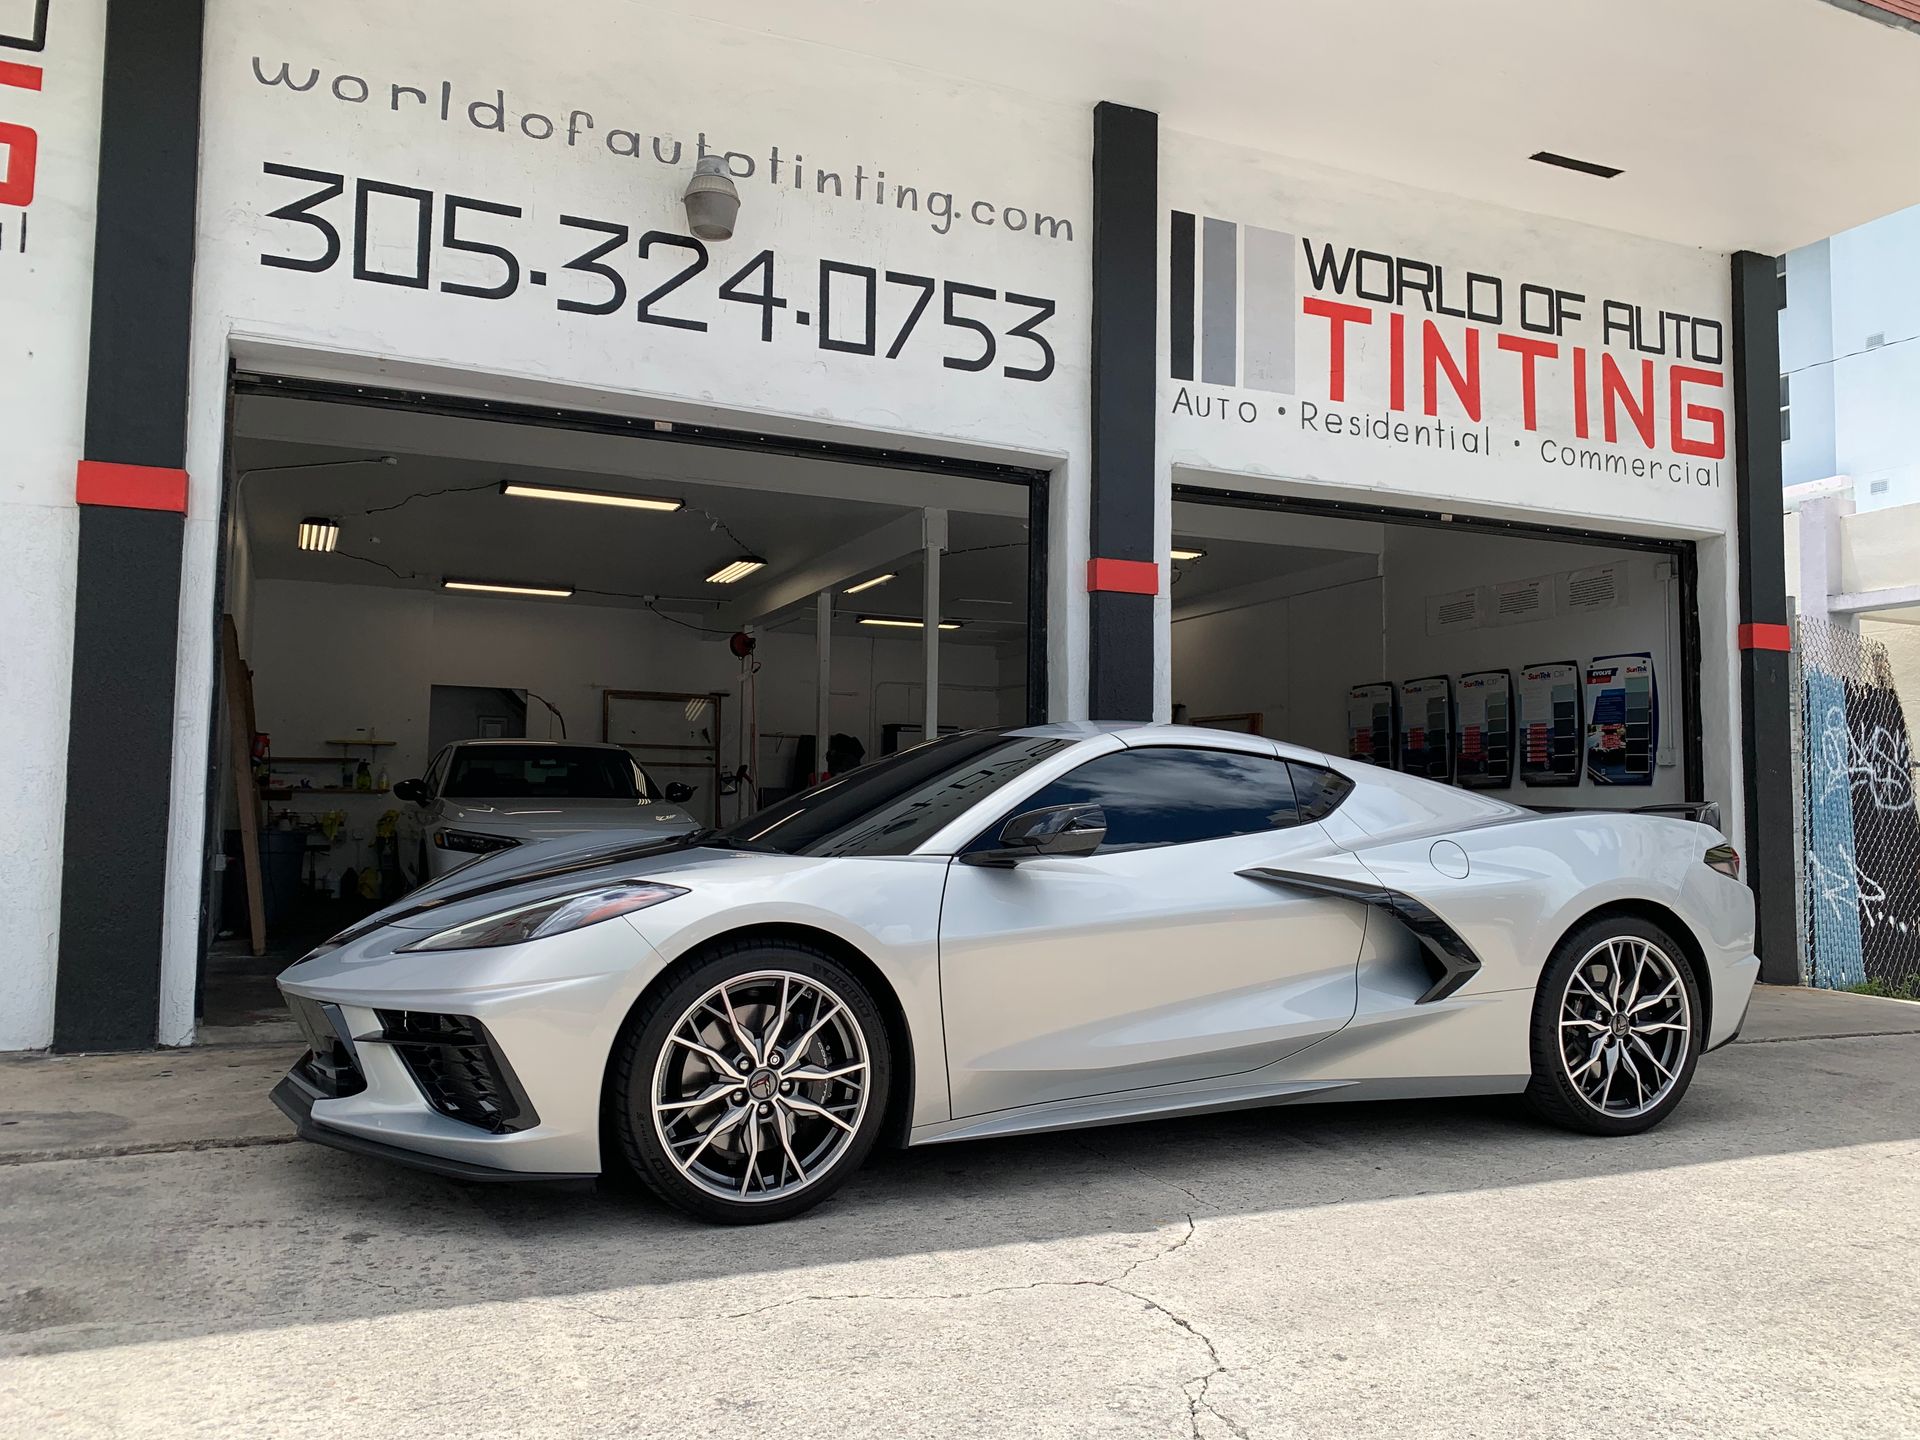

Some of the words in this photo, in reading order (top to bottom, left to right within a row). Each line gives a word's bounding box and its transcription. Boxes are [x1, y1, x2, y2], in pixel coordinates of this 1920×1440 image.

[252, 56, 1073, 242] worldofautotinting.com
[1302, 237, 1503, 326] WORLD
[1520, 283, 1586, 337] OF
[1603, 299, 1723, 365] AUTO
[1303, 296, 1726, 460] TINTING
[1301, 401, 1489, 456] Residential
[1540, 439, 1719, 488] Commercial
[1528, 671, 1551, 681] SunTek
[1626, 665, 1648, 673] SunTek
